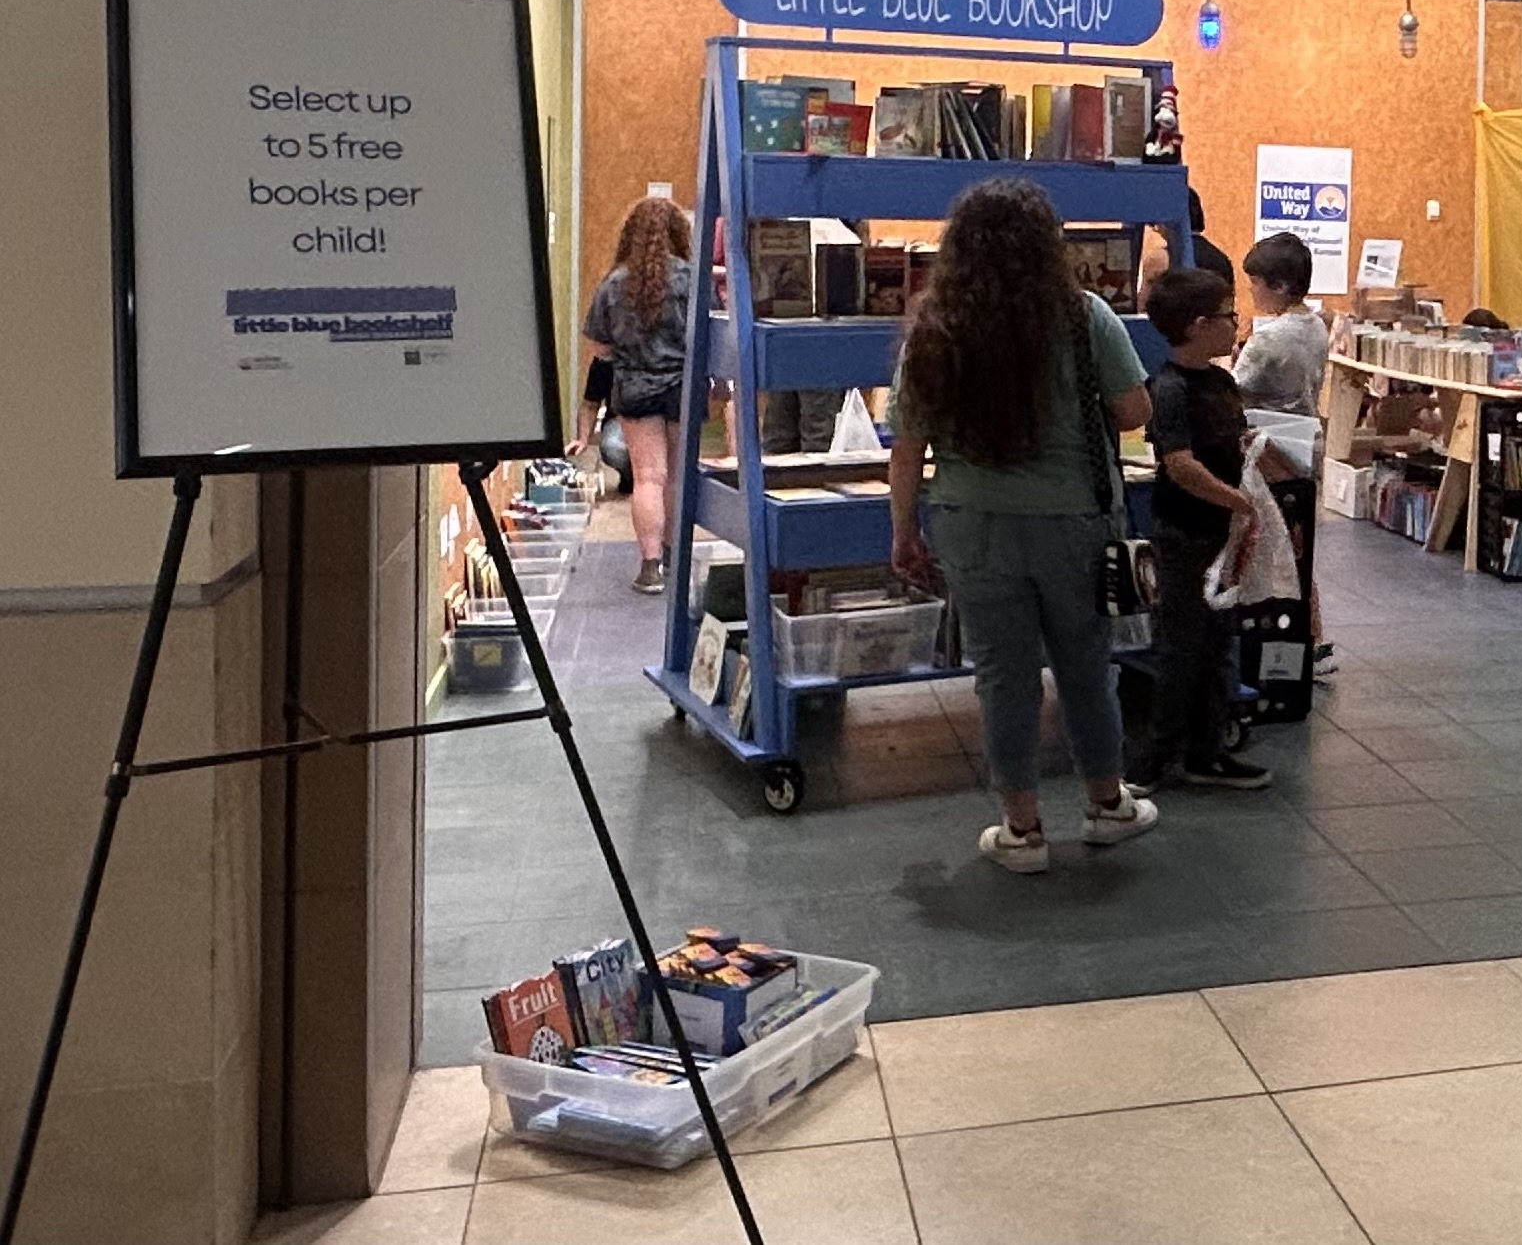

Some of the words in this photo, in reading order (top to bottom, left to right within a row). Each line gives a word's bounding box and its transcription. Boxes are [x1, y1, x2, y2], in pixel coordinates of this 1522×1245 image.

[249, 84, 359, 113] Select
[367, 92, 412, 119] up
[263, 133, 300, 160] to
[308, 133, 329, 159] 5
[333, 132, 404, 161] free
[249, 178, 358, 207] books
[366, 184, 423, 212] per
[1262, 184, 1311, 201] United
[1280, 200, 1311, 220] Way
[292, 227, 387, 254] child!
[234, 315, 289, 334] little
[292, 316, 341, 333] blue
[343, 312, 454, 333] bookshelf
[508, 980, 559, 1023] Fruit
